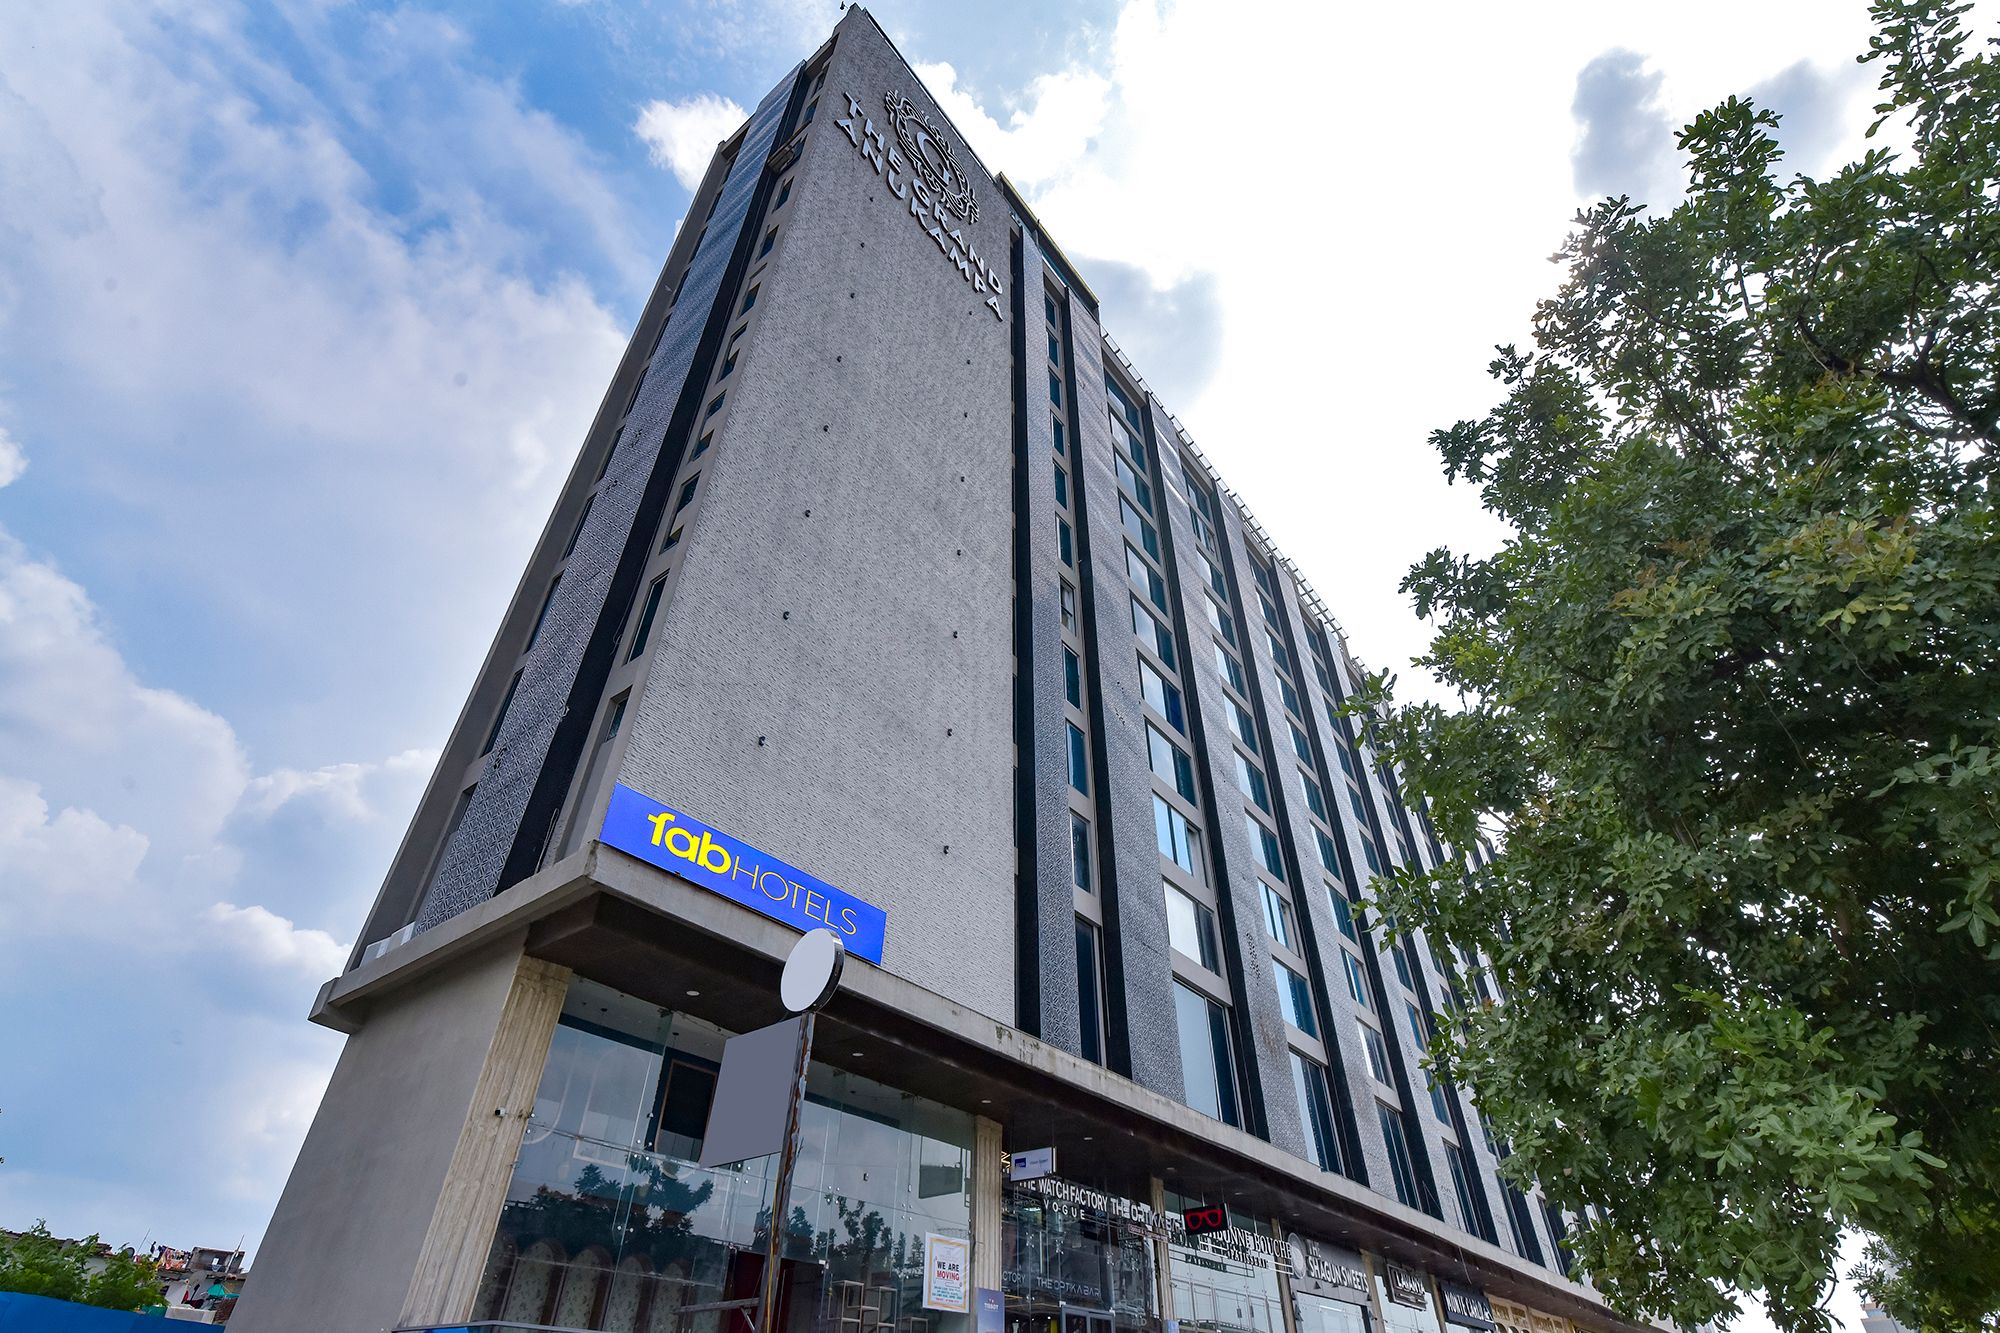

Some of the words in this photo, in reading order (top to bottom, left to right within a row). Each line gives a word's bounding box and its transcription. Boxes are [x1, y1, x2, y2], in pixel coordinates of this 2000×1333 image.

[843, 91, 903, 176] THE
[911, 178, 1004, 294] GRAND
[835, 117, 1004, 322] ANUKAMPA
[1043, 1199, 1085, 1220] VOGUE
[936, 1260, 946, 1270] WE
[947, 1262, 960, 1273] ARE
[936, 1270, 960, 1281] MOVING
